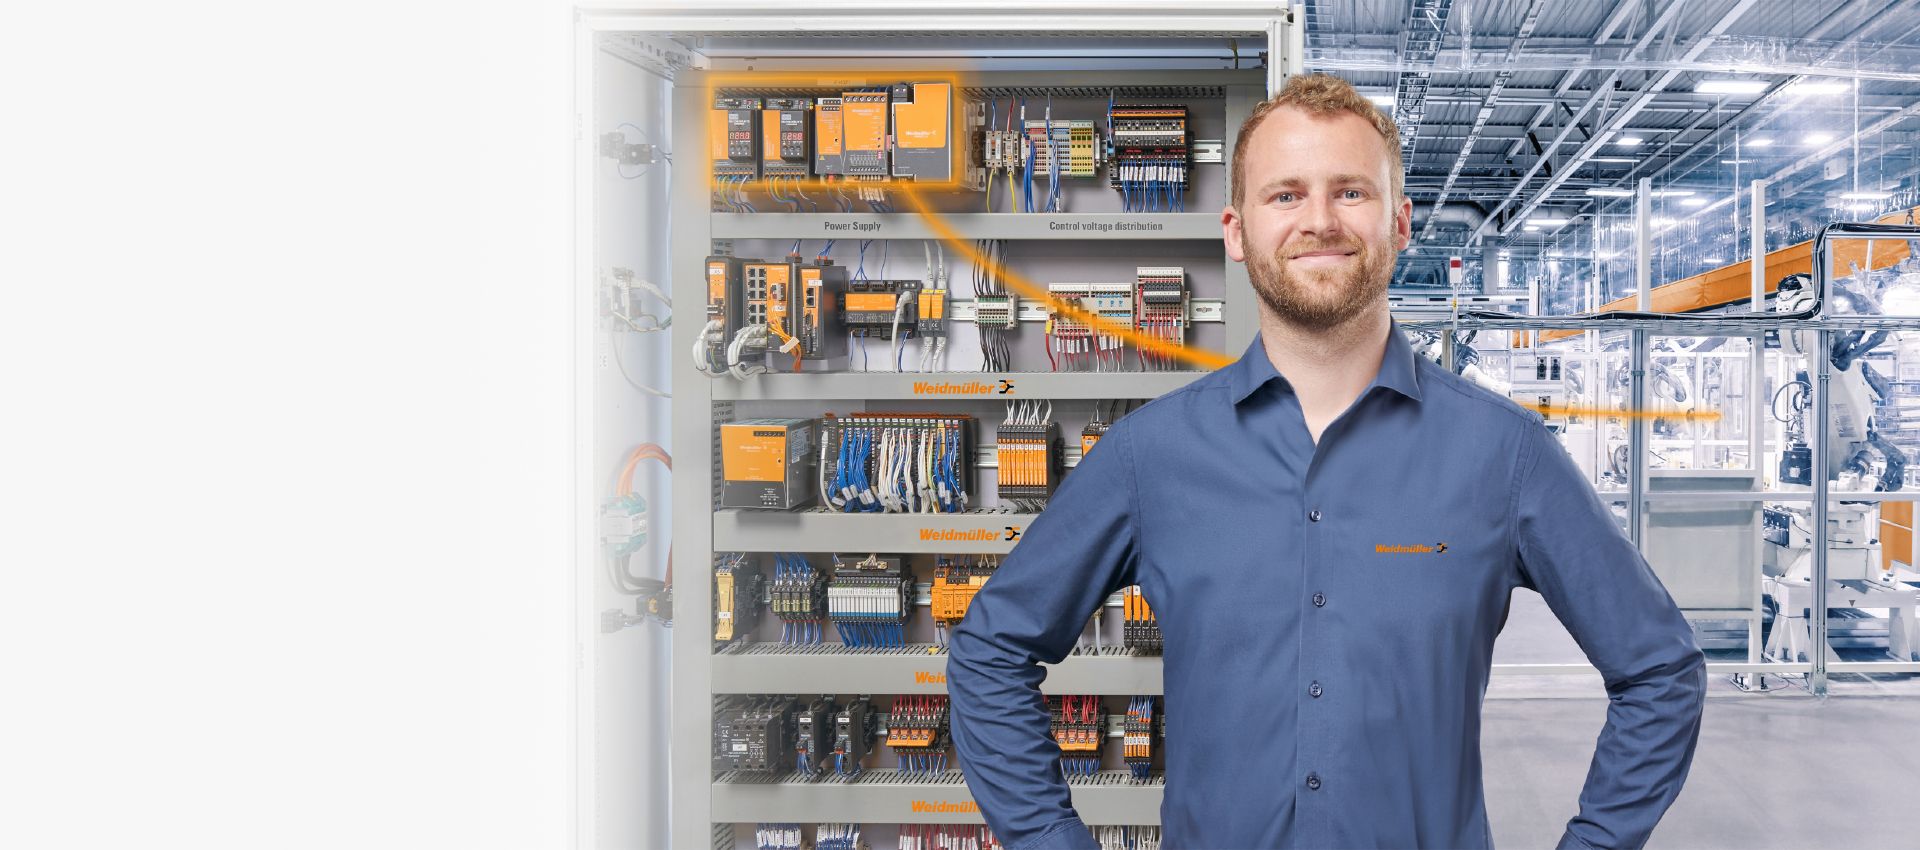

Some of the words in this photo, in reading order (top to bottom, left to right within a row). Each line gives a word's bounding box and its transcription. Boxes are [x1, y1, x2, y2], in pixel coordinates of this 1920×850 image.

[824, 221, 850, 231] Power
[853, 221, 881, 232] Supply
[1049, 221, 1080, 231] Control
[1082, 221, 1113, 232] voltage
[1115, 221, 1163, 231] distribution
[913, 382, 995, 395] Weidmüller
[919, 529, 1000, 541] Weidmüller
[1375, 544, 1433, 553] Weidmüller
[911, 800, 981, 813] Weidmüll
